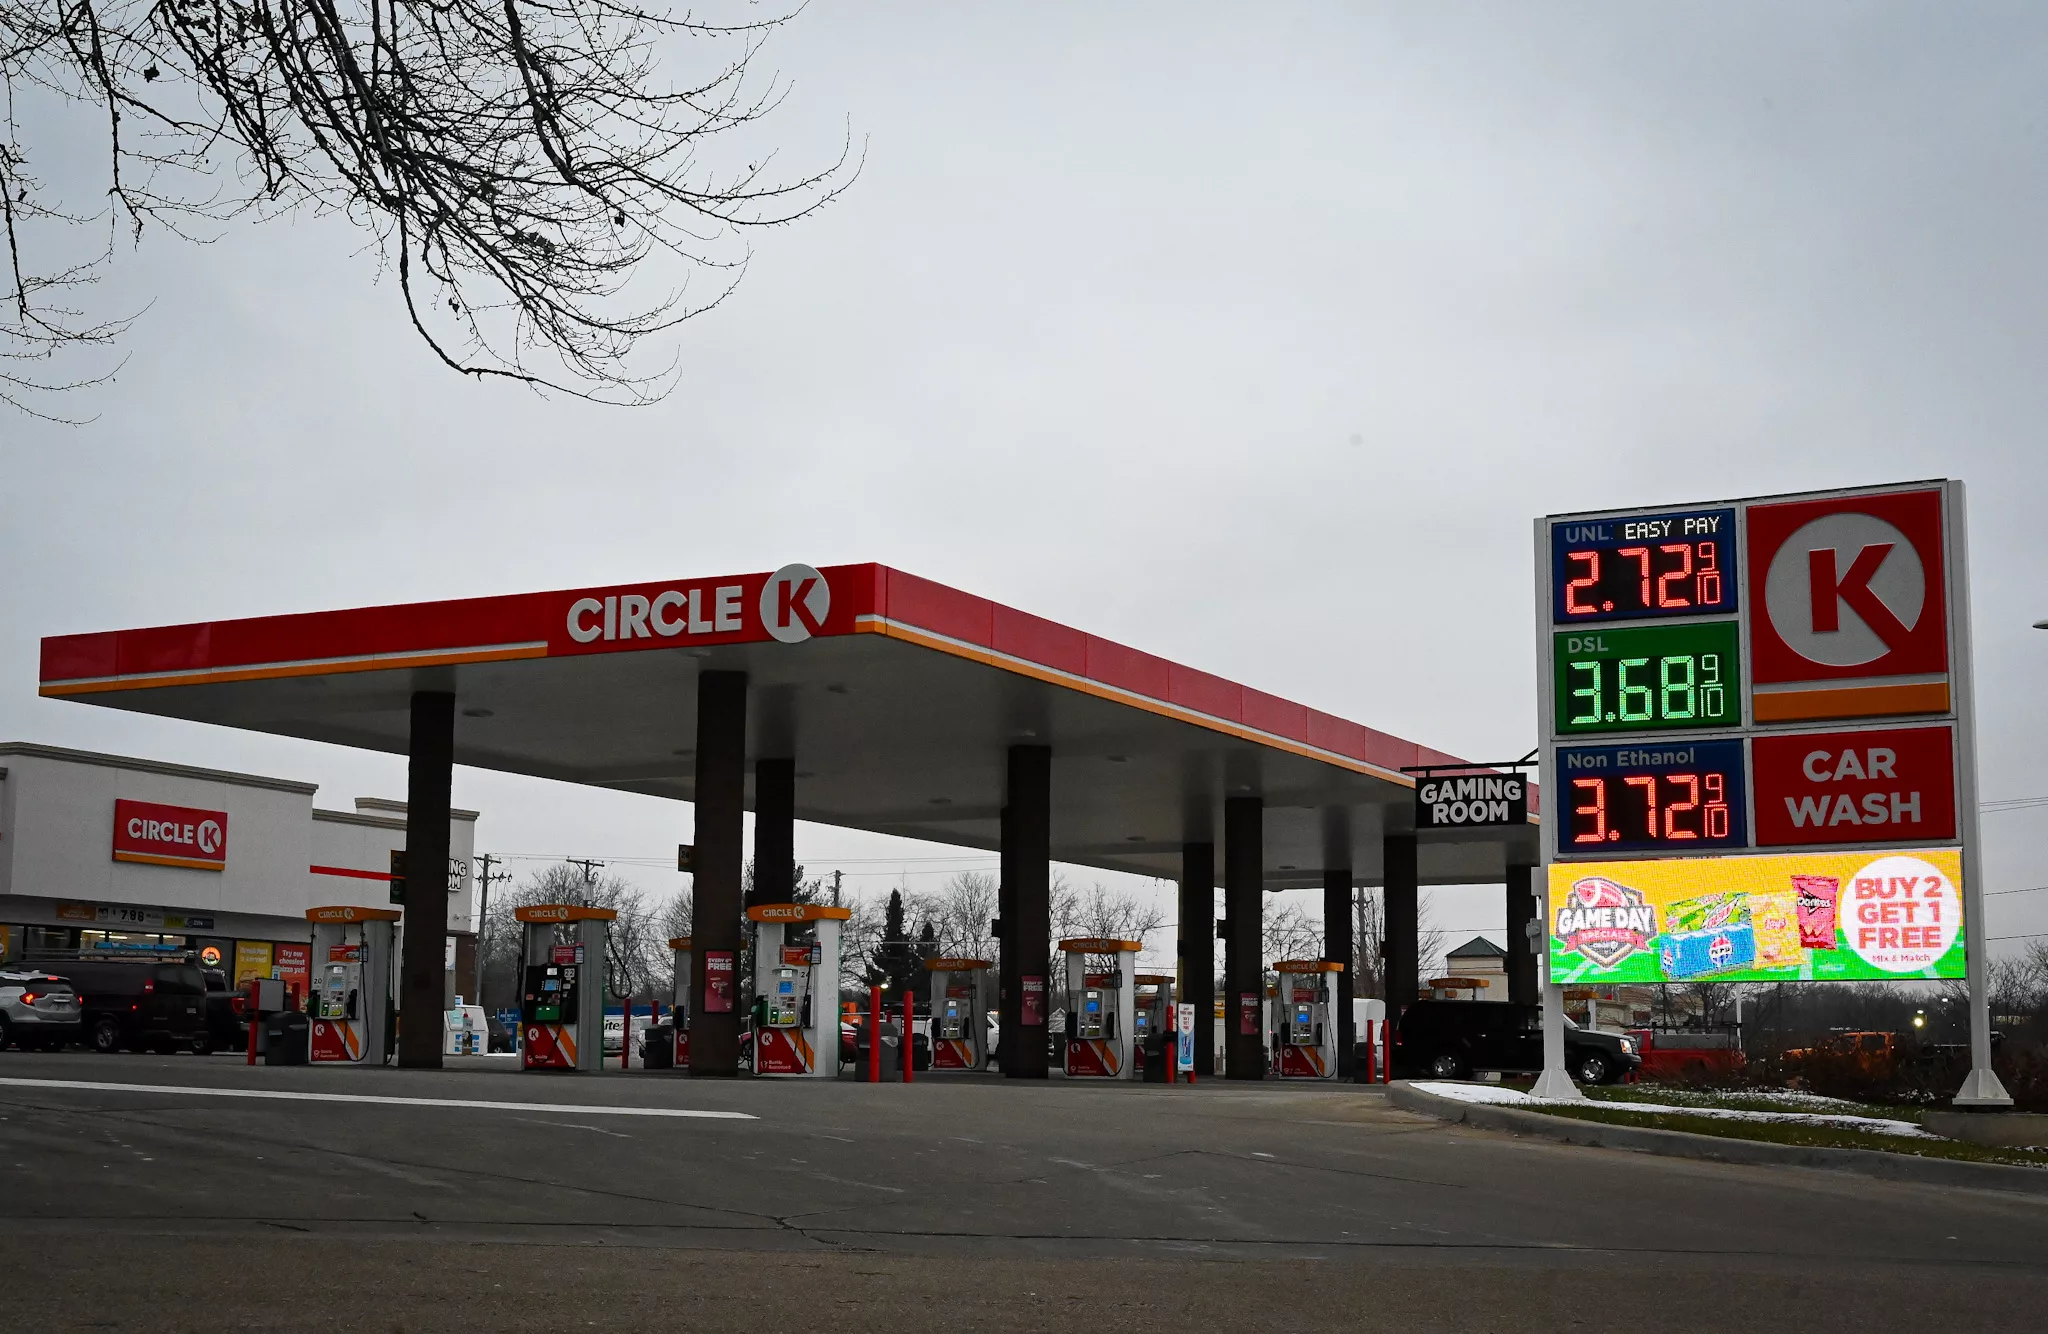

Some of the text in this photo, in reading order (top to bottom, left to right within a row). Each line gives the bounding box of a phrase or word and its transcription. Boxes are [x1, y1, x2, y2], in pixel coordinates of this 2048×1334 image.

[1566, 526, 1609, 543] UNL
[1625, 516, 1720, 539] EASY PAY
[567, 586, 742, 643] CIRCLE
[1567, 635, 1609, 653] DSL
[1567, 747, 1695, 769] Non Ethanol
[1802, 747, 1897, 782] CAR
[1420, 778, 1521, 804] GAMING
[1433, 801, 1508, 824] ROOM
[1784, 791, 1921, 827] WASH
[127, 817, 194, 845] CIRCLE
[1855, 876, 1943, 900] BUY 2
[318, 911, 343, 919] CIRCLE
[529, 910, 556, 918] CIRCLE
[762, 909, 792, 917] CIRCLE
[1559, 907, 1652, 934] GAME DAY
[1858, 902, 1941, 924] GET 1
[1858, 926, 1942, 949] FREE
[708, 963, 732, 971] FREE
[1901, 954, 1931, 962] Match
